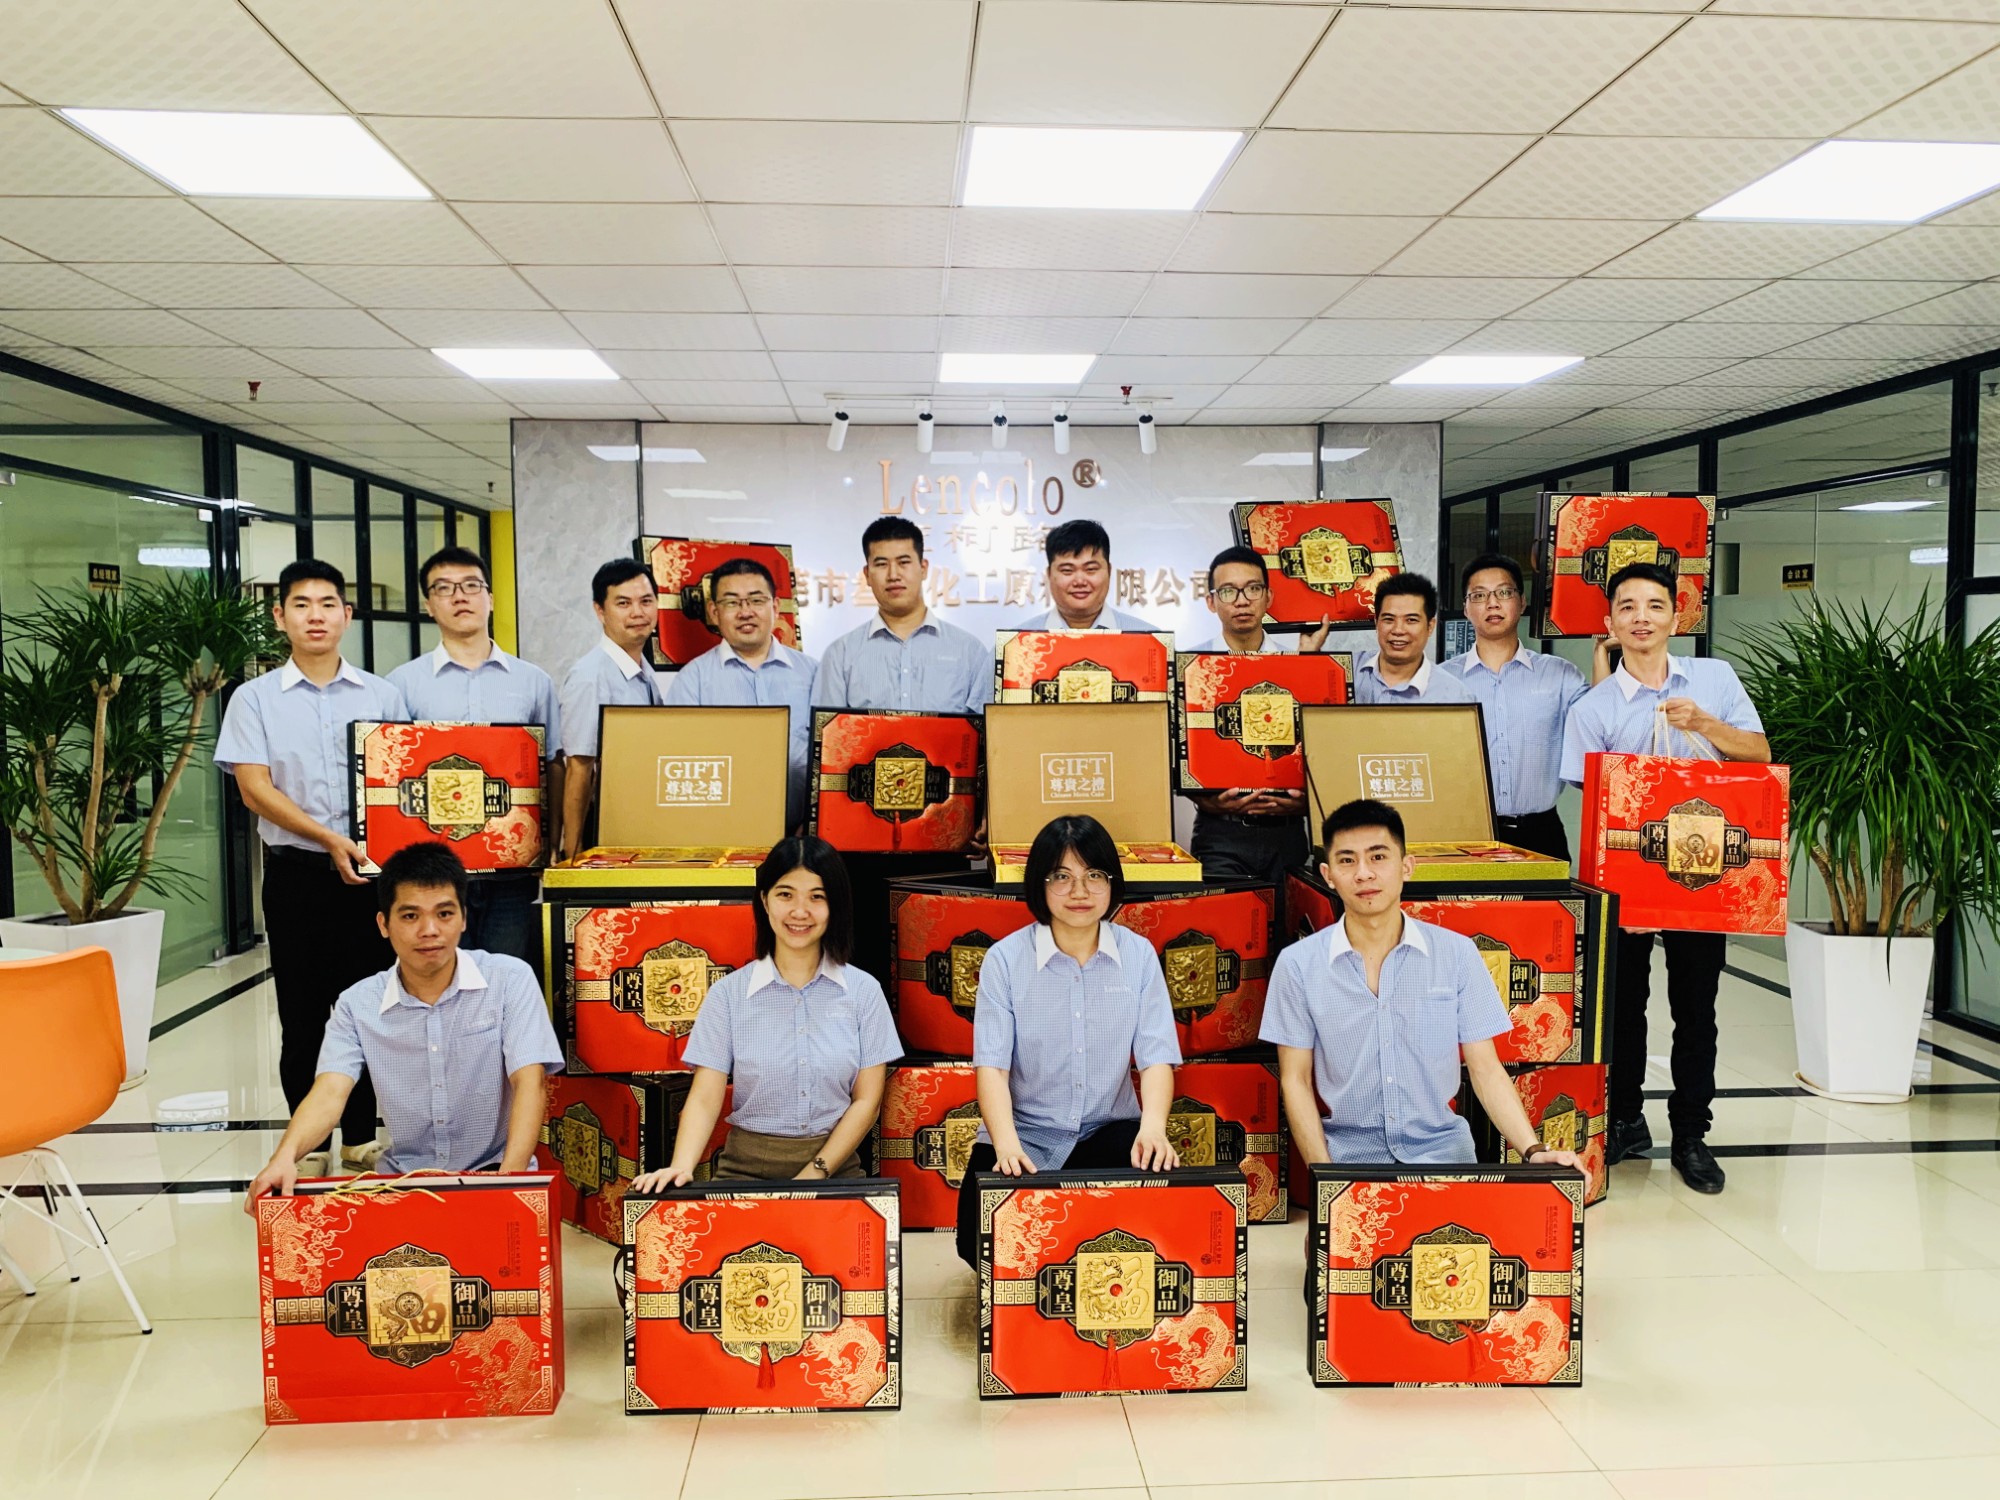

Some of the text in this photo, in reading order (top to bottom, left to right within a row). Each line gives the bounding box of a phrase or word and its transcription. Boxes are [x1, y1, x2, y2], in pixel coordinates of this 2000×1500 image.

[1594, 551, 1607, 581] 尊皇
[1227, 706, 1241, 736] 尊皇
[664, 761, 725, 780] GIFT
[1047, 757, 1107, 777] GIFT
[1365, 758, 1424, 777] GIFT
[411, 781, 427, 813] 尊皇
[485, 782, 500, 813] 御品
[1652, 825, 1667, 859] 尊皇
[1725, 830, 1741, 864] 御品
[626, 972, 643, 1007] 尊皇
[1217, 957, 1231, 990] 御品
[1511, 965, 1527, 999] 御品
[928, 1131, 944, 1166] 尊皇
[1052, 1269, 1075, 1313] 尊皇
[1156, 1268, 1178, 1312] 御品
[1388, 1262, 1410, 1305] 尊皇
[1492, 1262, 1513, 1305] 御品
[341, 1286, 366, 1331] 尊皇
[453, 1281, 476, 1327] 御品
[697, 1283, 720, 1328] 尊皇
[804, 1282, 827, 1328] 御品
